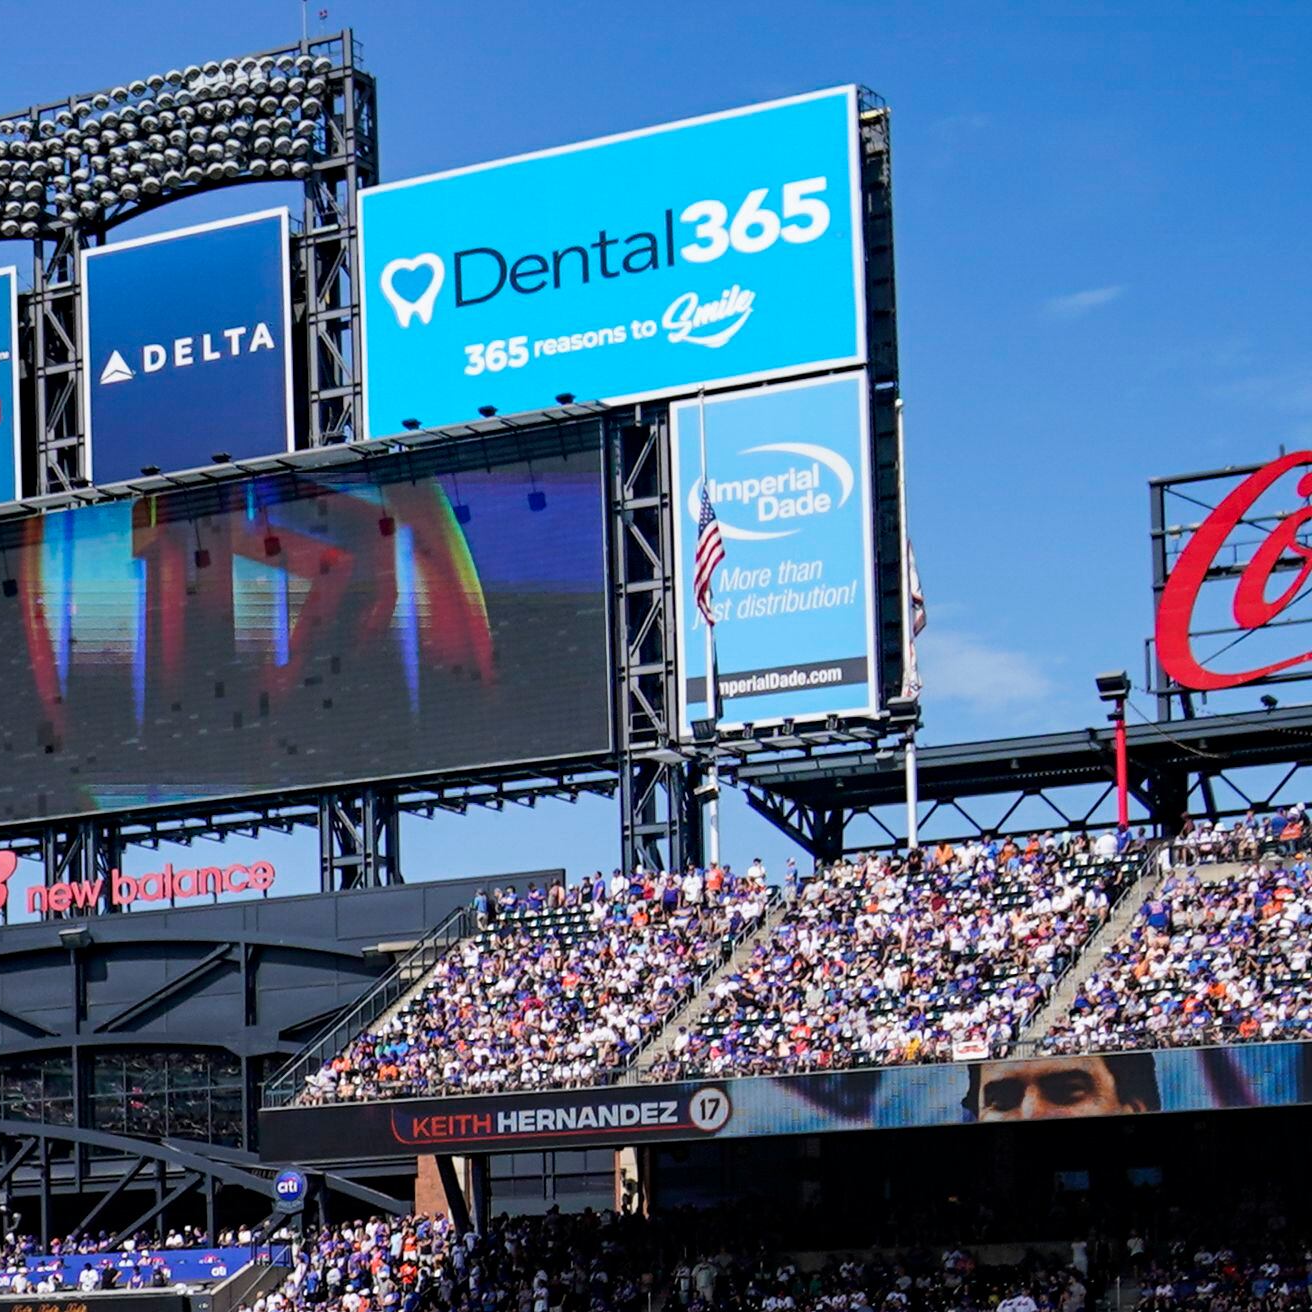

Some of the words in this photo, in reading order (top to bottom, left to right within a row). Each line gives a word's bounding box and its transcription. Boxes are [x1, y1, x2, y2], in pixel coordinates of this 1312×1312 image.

[452, 175, 831, 308] Dental365
[142, 322, 275, 373] DELTA
[464, 335, 529, 377] 365
[533, 325, 627, 359] reasons
[631, 319, 658, 341] to
[662, 284, 756, 343] Smile
[707, 462, 820, 505] Imperial
[758, 490, 832, 522] Dade
[719, 565, 772, 593] More
[778, 559, 823, 585] than
[692, 601, 732, 631] jst
[737, 580, 858, 620] distribution!
[26, 878, 102, 914] new
[111, 860, 276, 906] balance
[411, 1113, 493, 1138] KEITH
[497, 1101, 678, 1133] HERNANDEZ
[698, 1098, 722, 1121] 17
